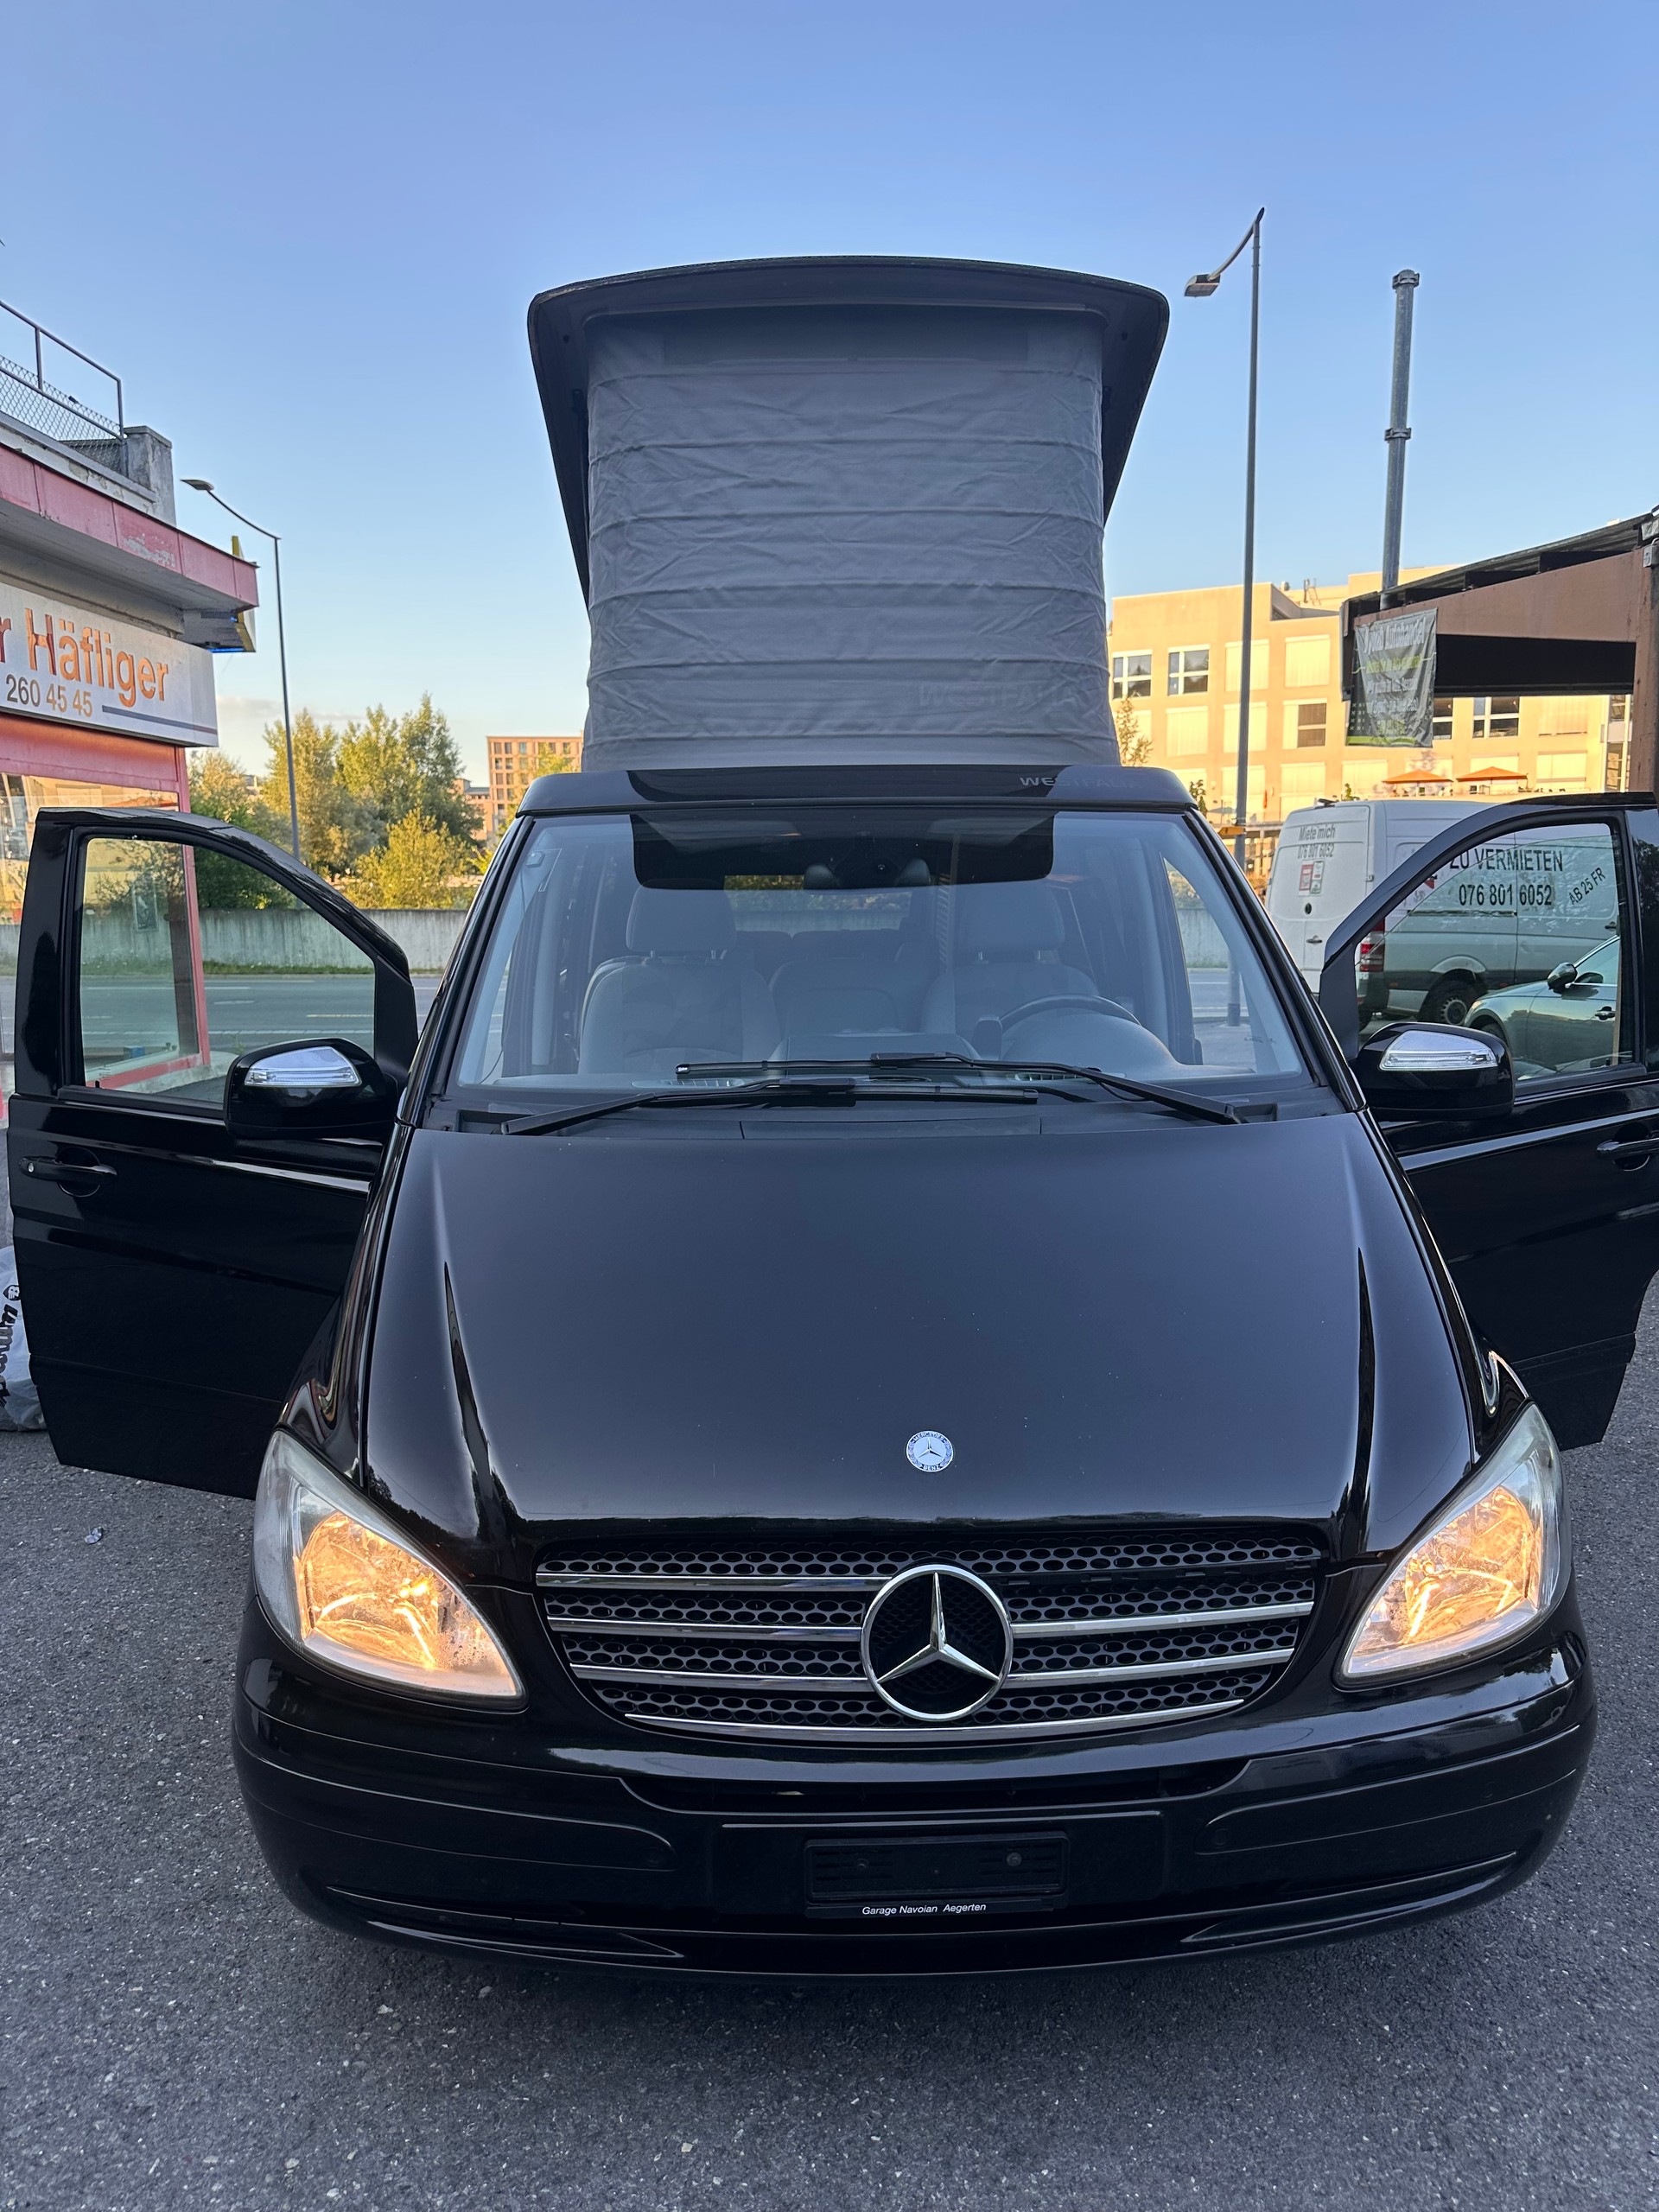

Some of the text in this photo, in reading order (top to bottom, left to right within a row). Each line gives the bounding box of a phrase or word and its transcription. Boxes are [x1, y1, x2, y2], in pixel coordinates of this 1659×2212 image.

[24, 607, 169, 708] Häfliger
[6, 673, 93, 717] 260 45 45
[1020, 777, 1143, 789] WESTFALIA
[1299, 823, 1336, 842] Miete mich
[1476, 848, 1564, 872] VERMIETEN
[1459, 883, 1553, 906] 076 801 6052
[1568, 866, 1606, 906] AB 25 FR
[861, 1906, 898, 1916] Garage
[943, 1903, 987, 1914] Aegerten
